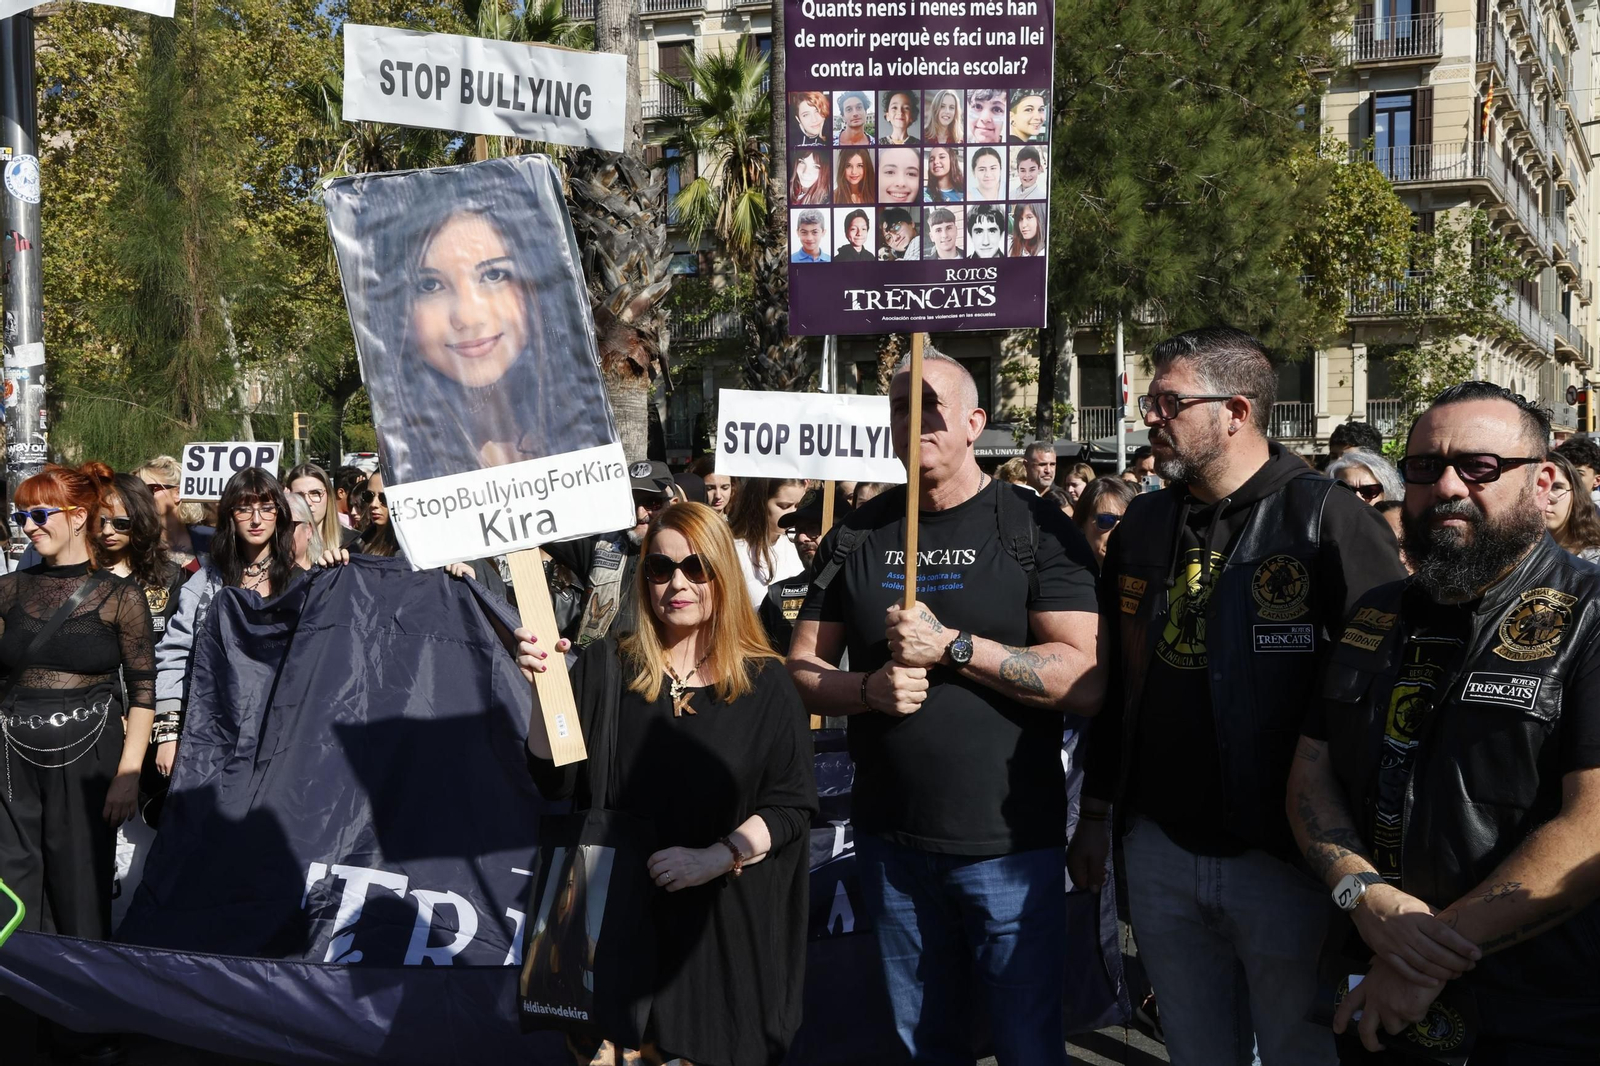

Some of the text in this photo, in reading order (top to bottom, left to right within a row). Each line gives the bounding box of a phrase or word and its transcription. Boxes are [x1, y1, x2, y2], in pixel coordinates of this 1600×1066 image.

[801, 0, 1037, 19] Quants nens i nenes més han
[794, 26, 1045, 51] de morir perquè es faci una llei
[811, 56, 1028, 77] contra la violència escolar?
[380, 59, 592, 120] STOP BULLYING
[945, 267, 998, 282] ROTOS
[843, 285, 996, 311] TRENCATS
[724, 421, 898, 459] STOP BULLYI
[187, 446, 275, 472] STOP
[390, 460, 626, 524] #StopBullyingForKira
[478, 507, 558, 547] Kira
[885, 549, 976, 567] TRNCATS
[926, 573, 949, 581] contra
[950, 571, 961, 580] les
[937, 582, 964, 591] escoles
[1261, 607, 1305, 619] CATALUNYA
[1256, 635, 1311, 645] TRENCATS
[1344, 631, 1381, 648] ESIDENTE
[1468, 682, 1534, 699] TRENCATS
[1510, 677, 1537, 687] ROTOS
[523, 1000, 589, 1021] #eldiariodekira
